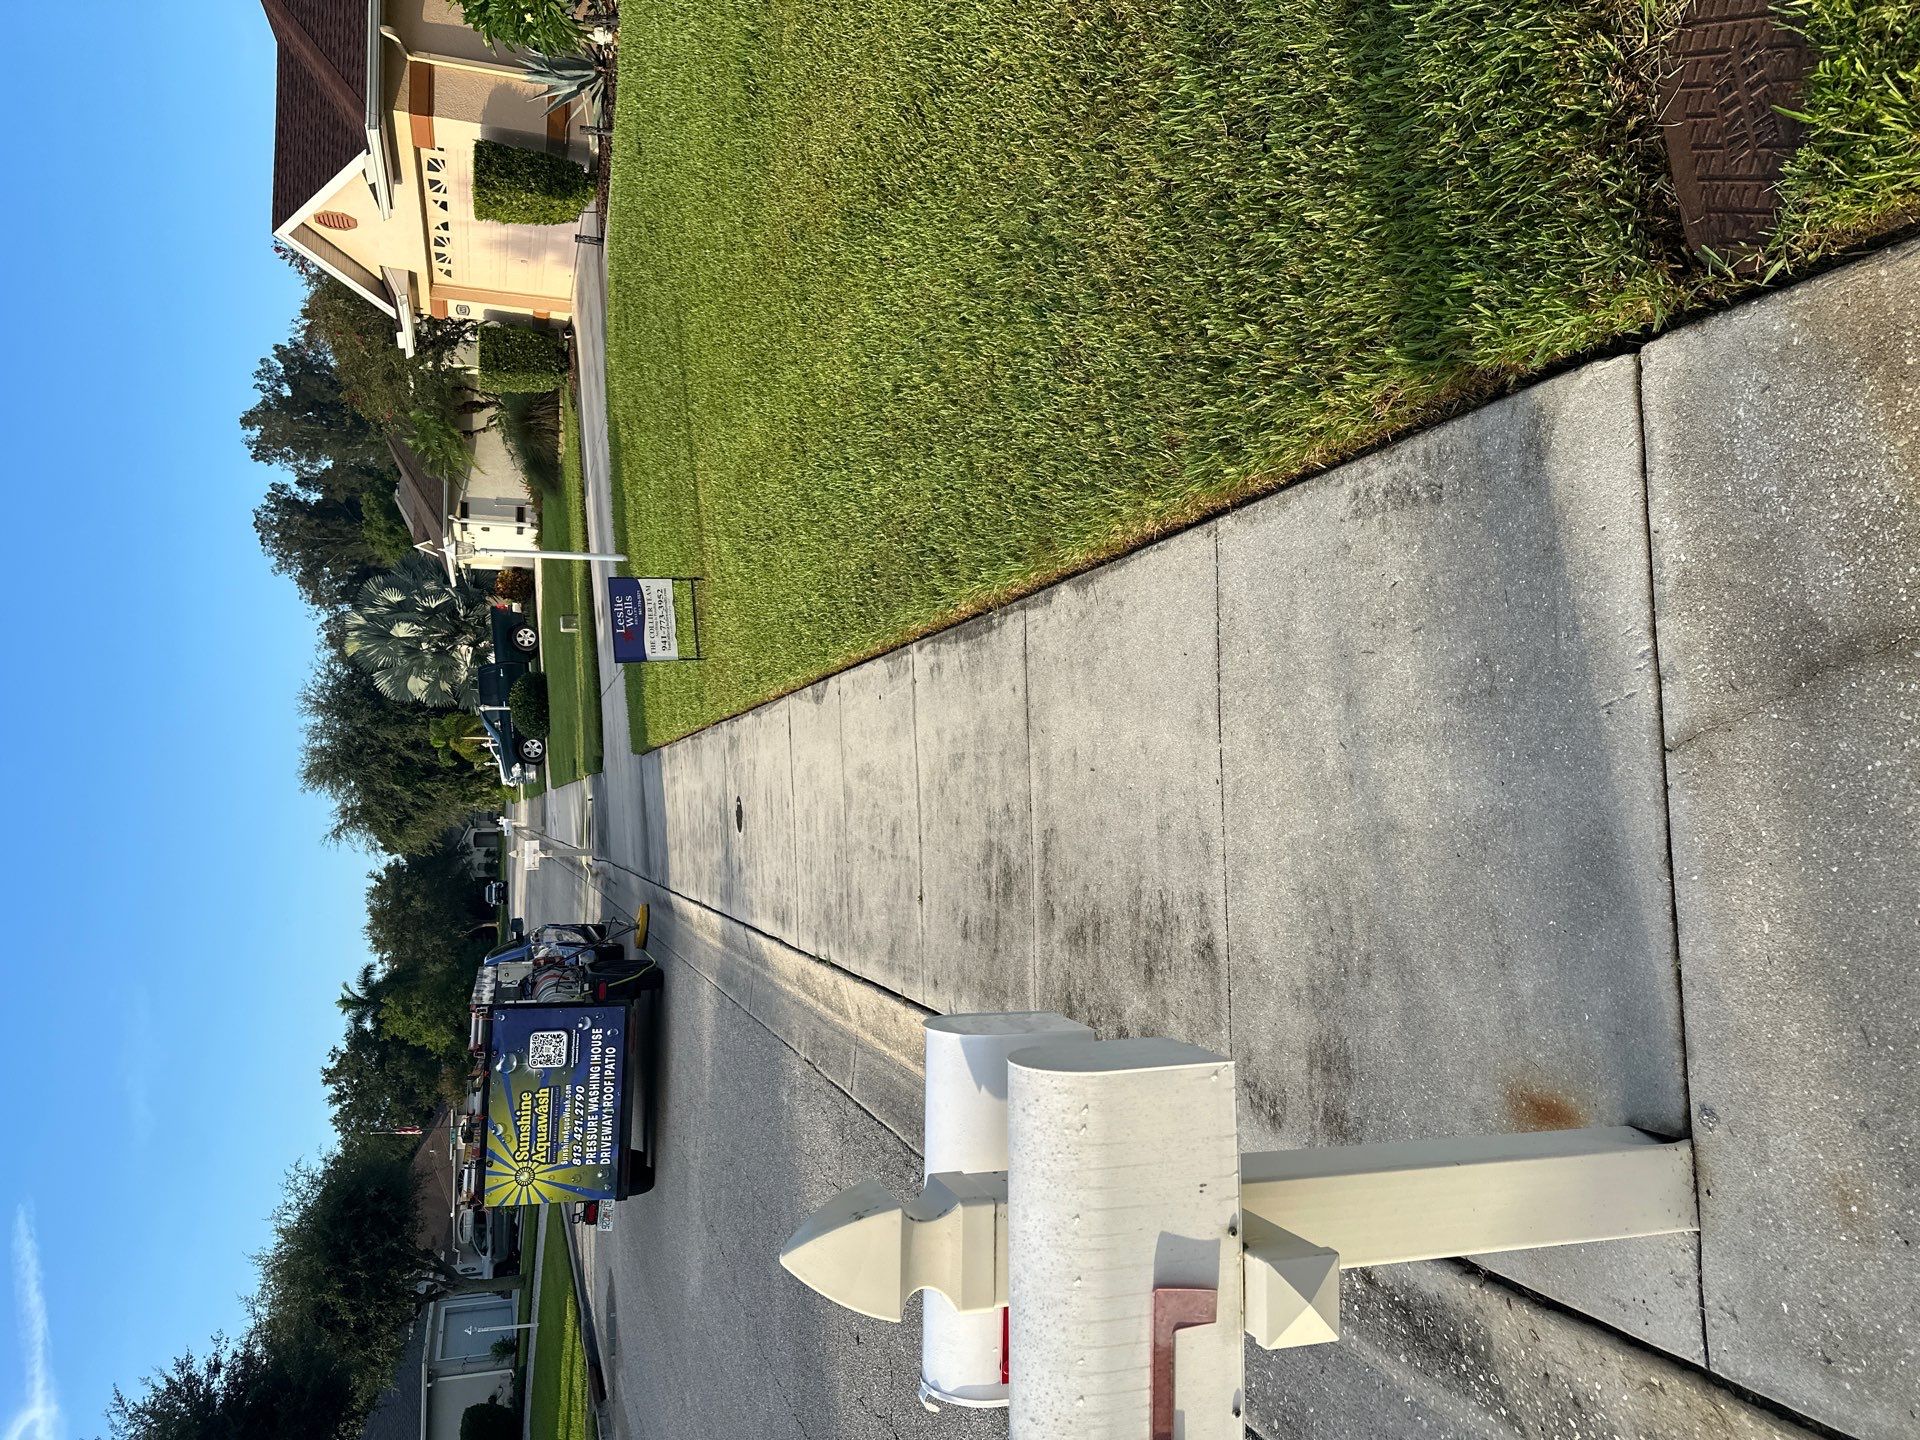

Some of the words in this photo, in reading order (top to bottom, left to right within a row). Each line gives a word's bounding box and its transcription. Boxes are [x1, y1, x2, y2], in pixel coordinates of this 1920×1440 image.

[614, 595, 625, 633] Leslie
[624, 595, 634, 627] Wells
[645, 585, 653, 606] TEAM
[647, 607, 655, 639] COLLIER
[656, 588, 668, 651] 941-773-3952
[514, 1092, 532, 1161] Sunshine
[532, 1087, 551, 1163] Aquawash
[560, 1084, 572, 1165] SunshineAquaWash.com
[572, 1085, 585, 1166] 813.421.2790
[586, 1115, 599, 1165] PRESSURE
